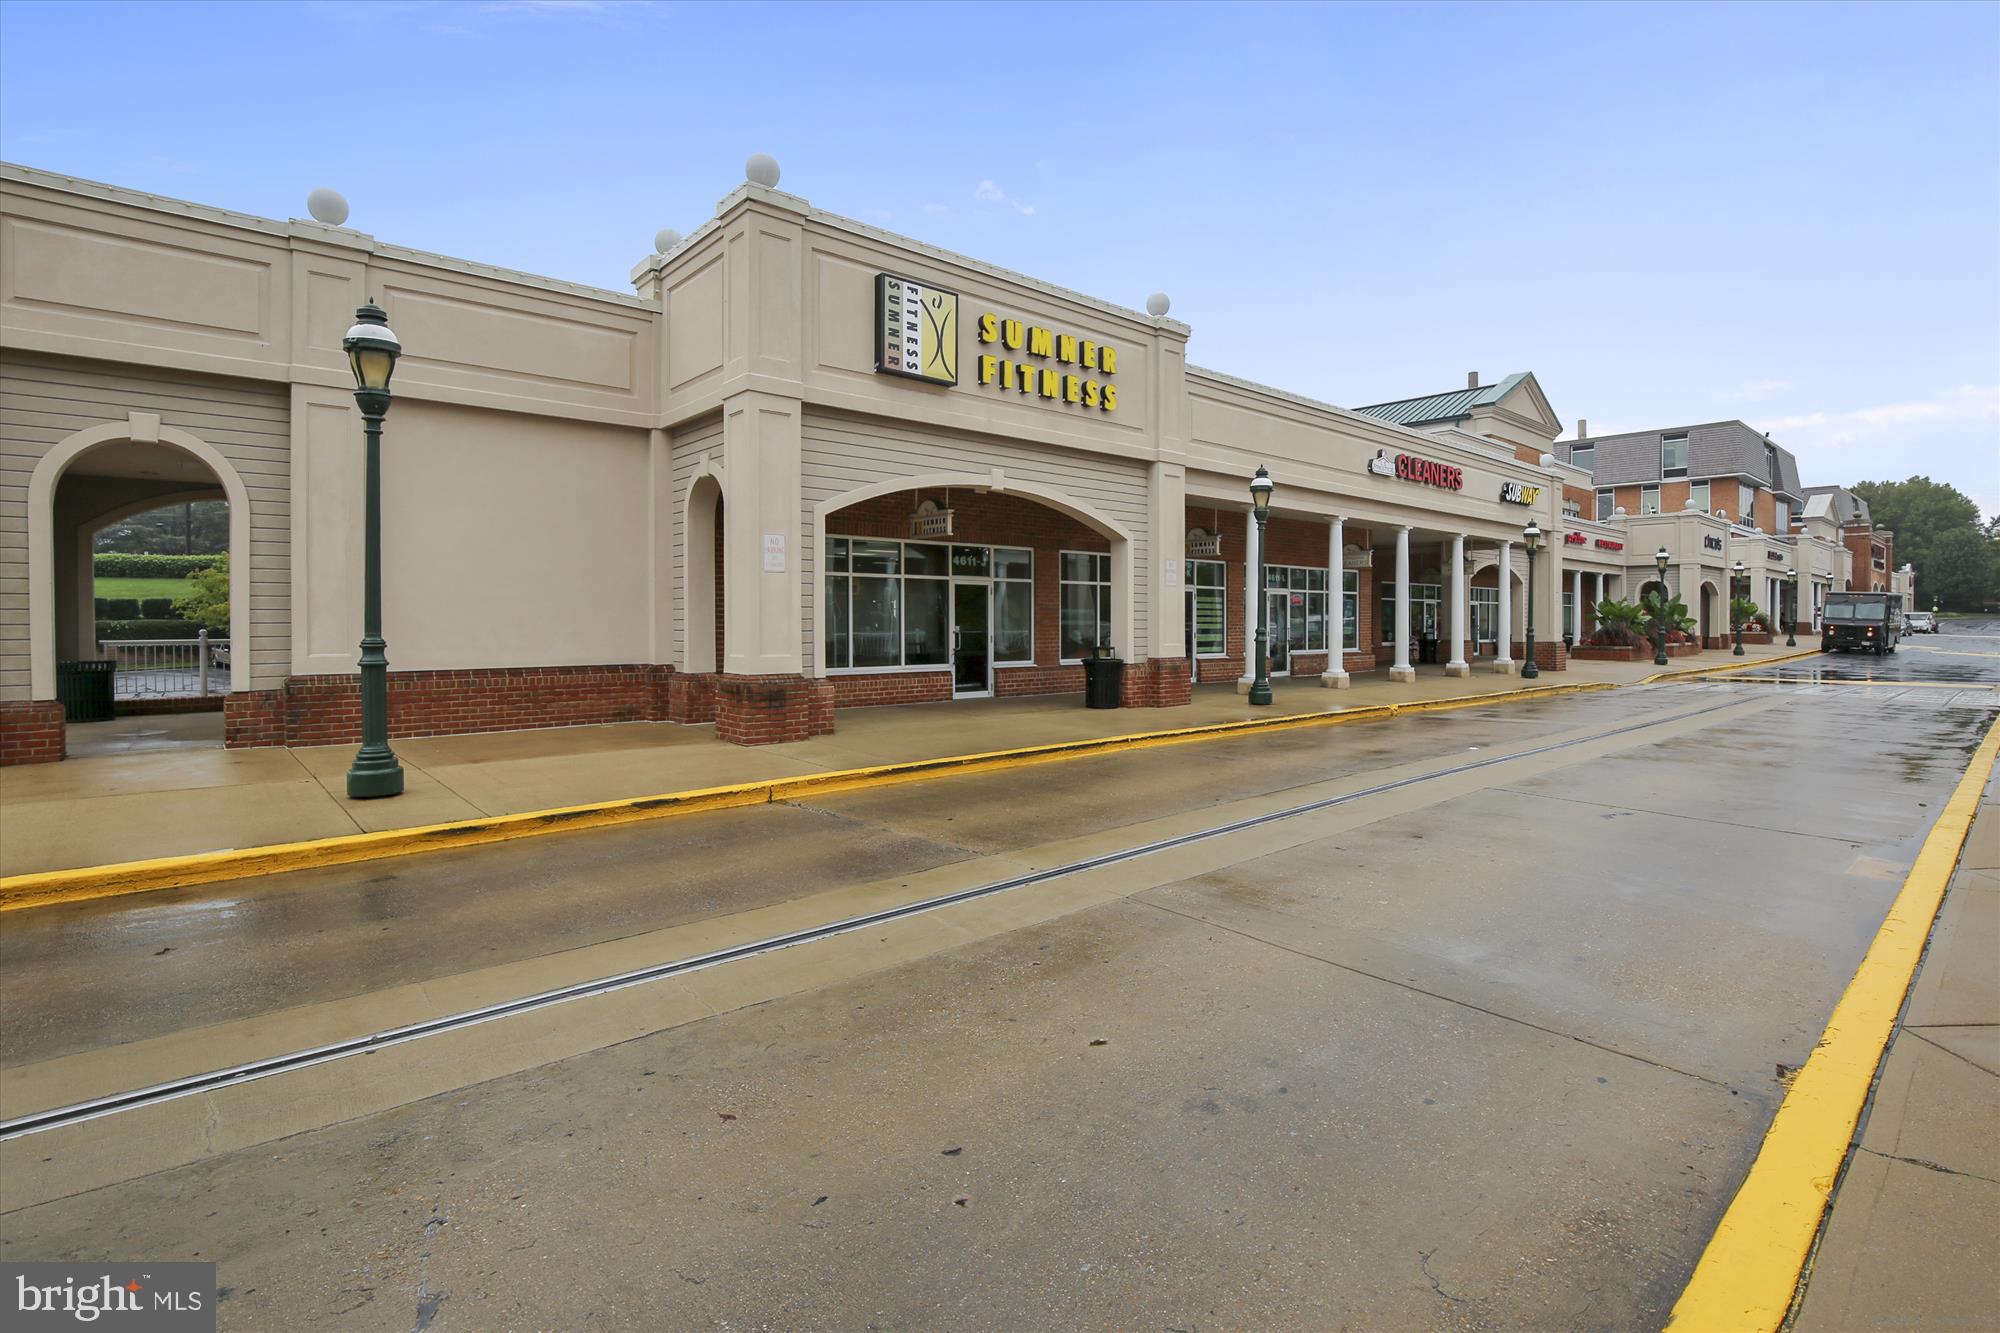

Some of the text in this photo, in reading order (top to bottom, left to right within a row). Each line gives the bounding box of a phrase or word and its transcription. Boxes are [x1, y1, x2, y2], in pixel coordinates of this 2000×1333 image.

[888, 280, 900, 366] SUMNER
[906, 286, 918, 371] FITNESS
[978, 313, 1117, 375] SUMNER
[978, 354, 1118, 412] FITNESS
[1397, 453, 1463, 490] CLEANERS
[1502, 482, 1541, 506] SUBWAY
